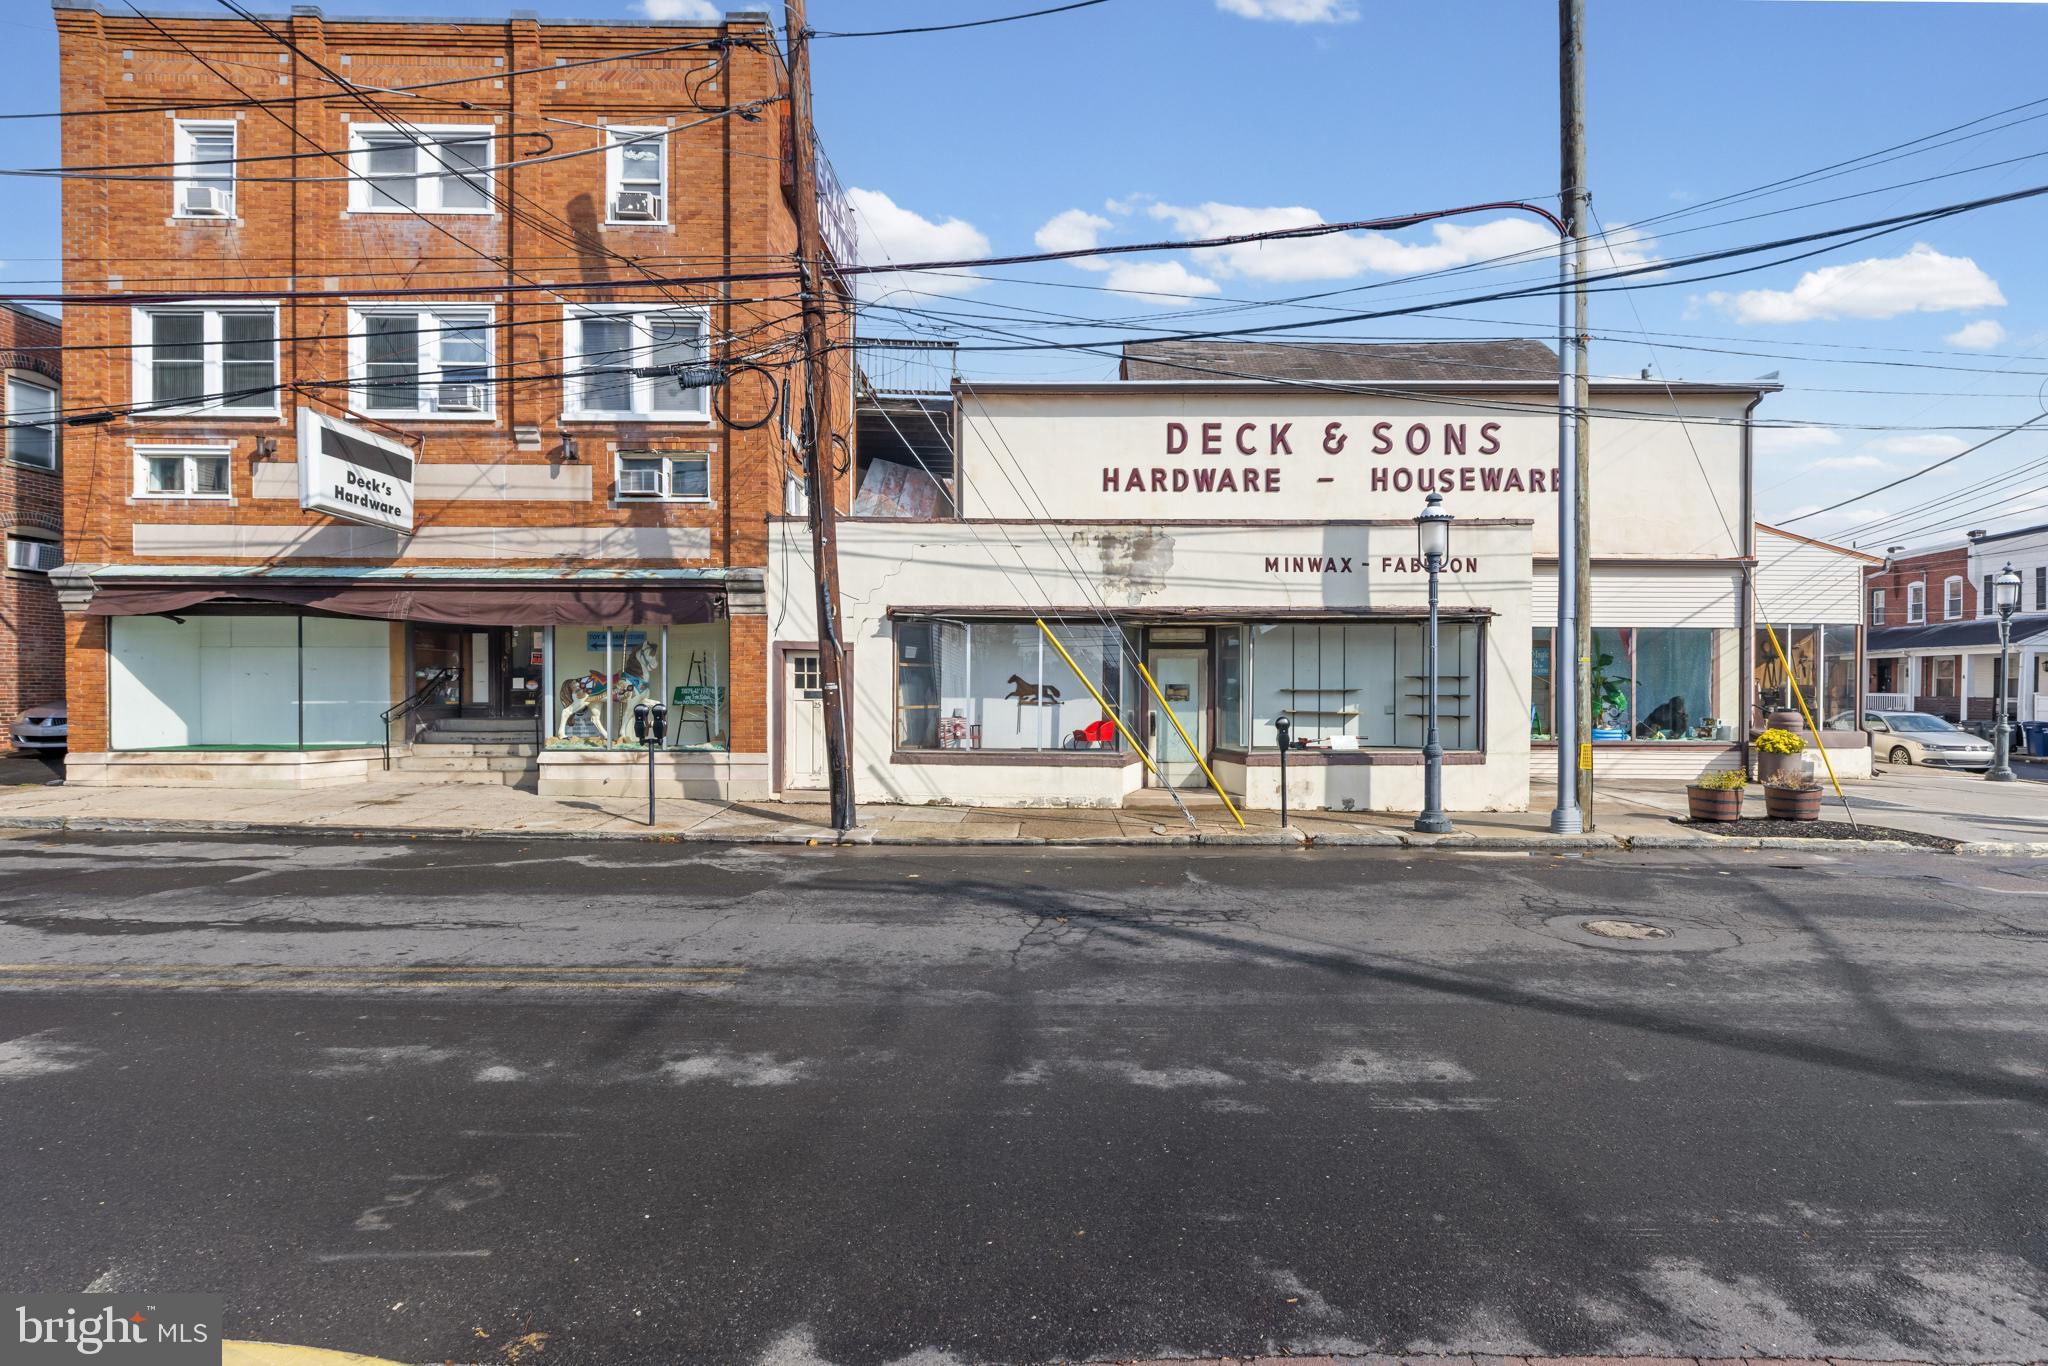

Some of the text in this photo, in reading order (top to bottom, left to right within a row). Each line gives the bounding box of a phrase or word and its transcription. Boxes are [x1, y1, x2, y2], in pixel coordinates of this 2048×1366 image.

[818, 149, 846, 231] ECK'S
[1166, 421, 1502, 456] DECK & SONS
[346, 470, 392, 496] Deck's
[1102, 467, 1281, 493] HARDWARE
[1371, 467, 1560, 493] HOUSEWARE
[334, 485, 402, 517] Hardware
[1265, 557, 1353, 573] MINWAX
